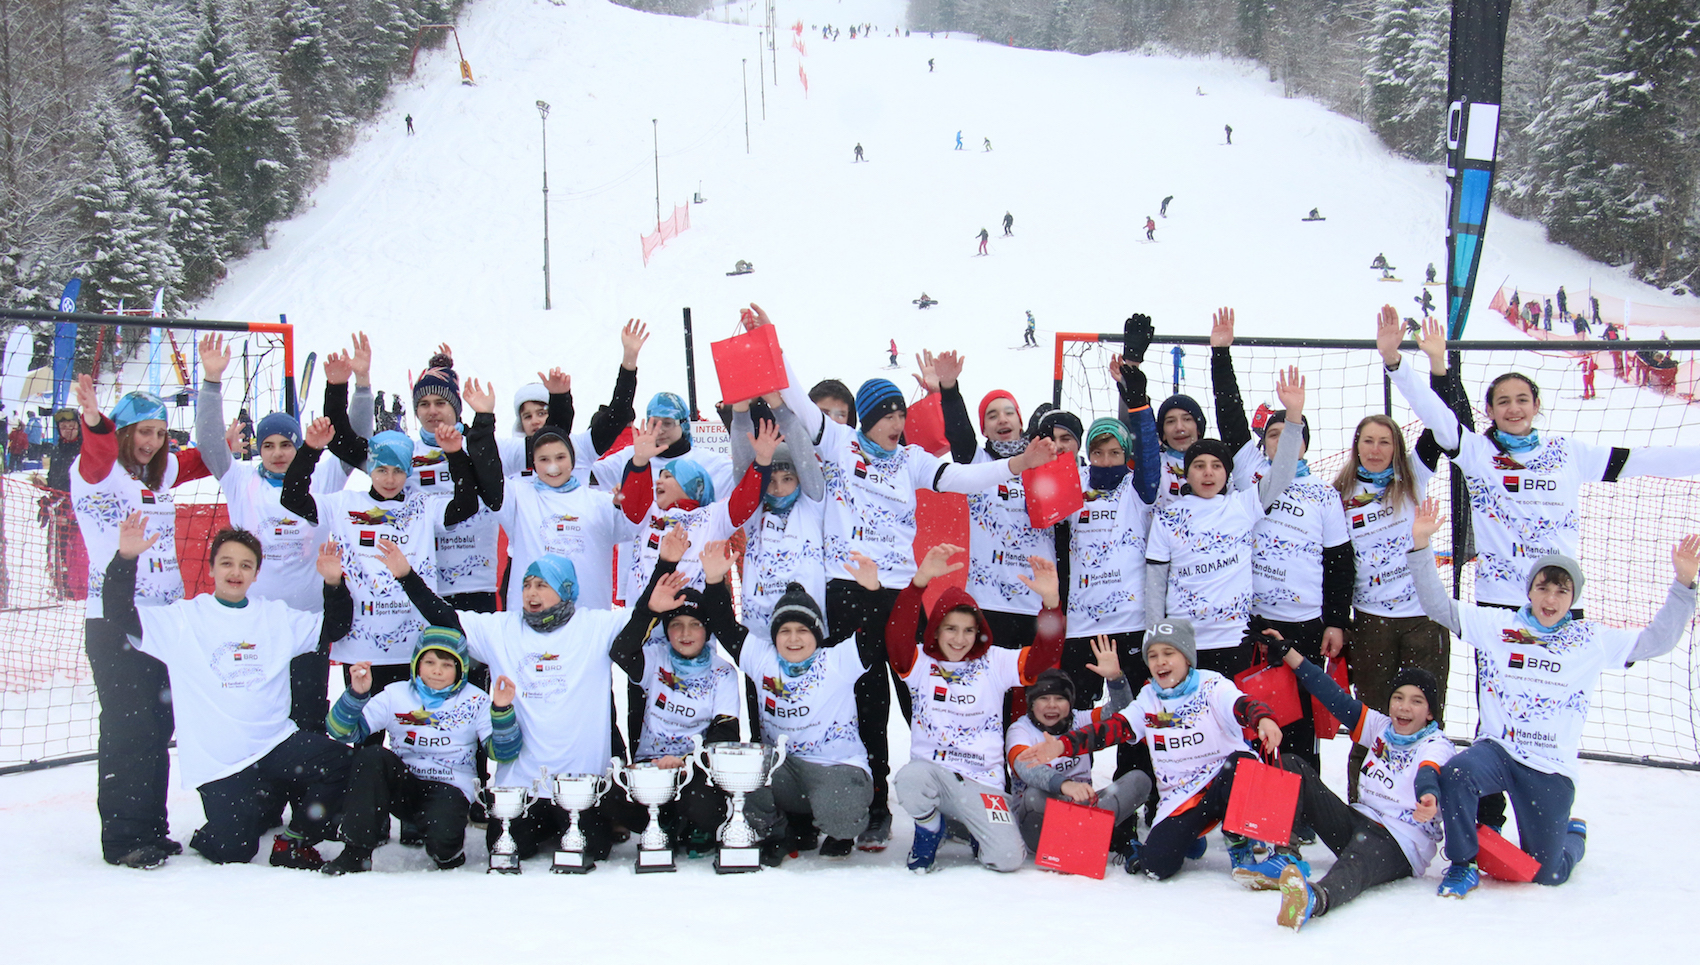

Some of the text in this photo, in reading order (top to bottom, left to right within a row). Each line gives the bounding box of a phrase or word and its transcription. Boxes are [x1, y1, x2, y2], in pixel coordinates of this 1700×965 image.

[706, 436, 718, 444] CU
[718, 446, 729, 454] DE
[1523, 478, 1557, 491] BRD
[1366, 506, 1395, 523] BRD
[440, 535, 475, 545] Handbalul
[375, 600, 411, 610] Handbalul
[375, 609, 391, 617] Sport
[1527, 656, 1562, 673] BRD
[666, 701, 696, 718] BRD
[777, 705, 810, 719] BRD
[1168, 732, 1205, 749] BRD
[1516, 728, 1557, 742] Handbalul
[418, 736, 451, 747] BRD
[1516, 737, 1533, 747] Sport
[949, 749, 986, 761] Handbalul
[1193, 749, 1221, 760] GENERALE
[1055, 756, 1081, 772] BRD
[411, 765, 454, 776] Handbalul
[992, 811, 1011, 823] ALI
